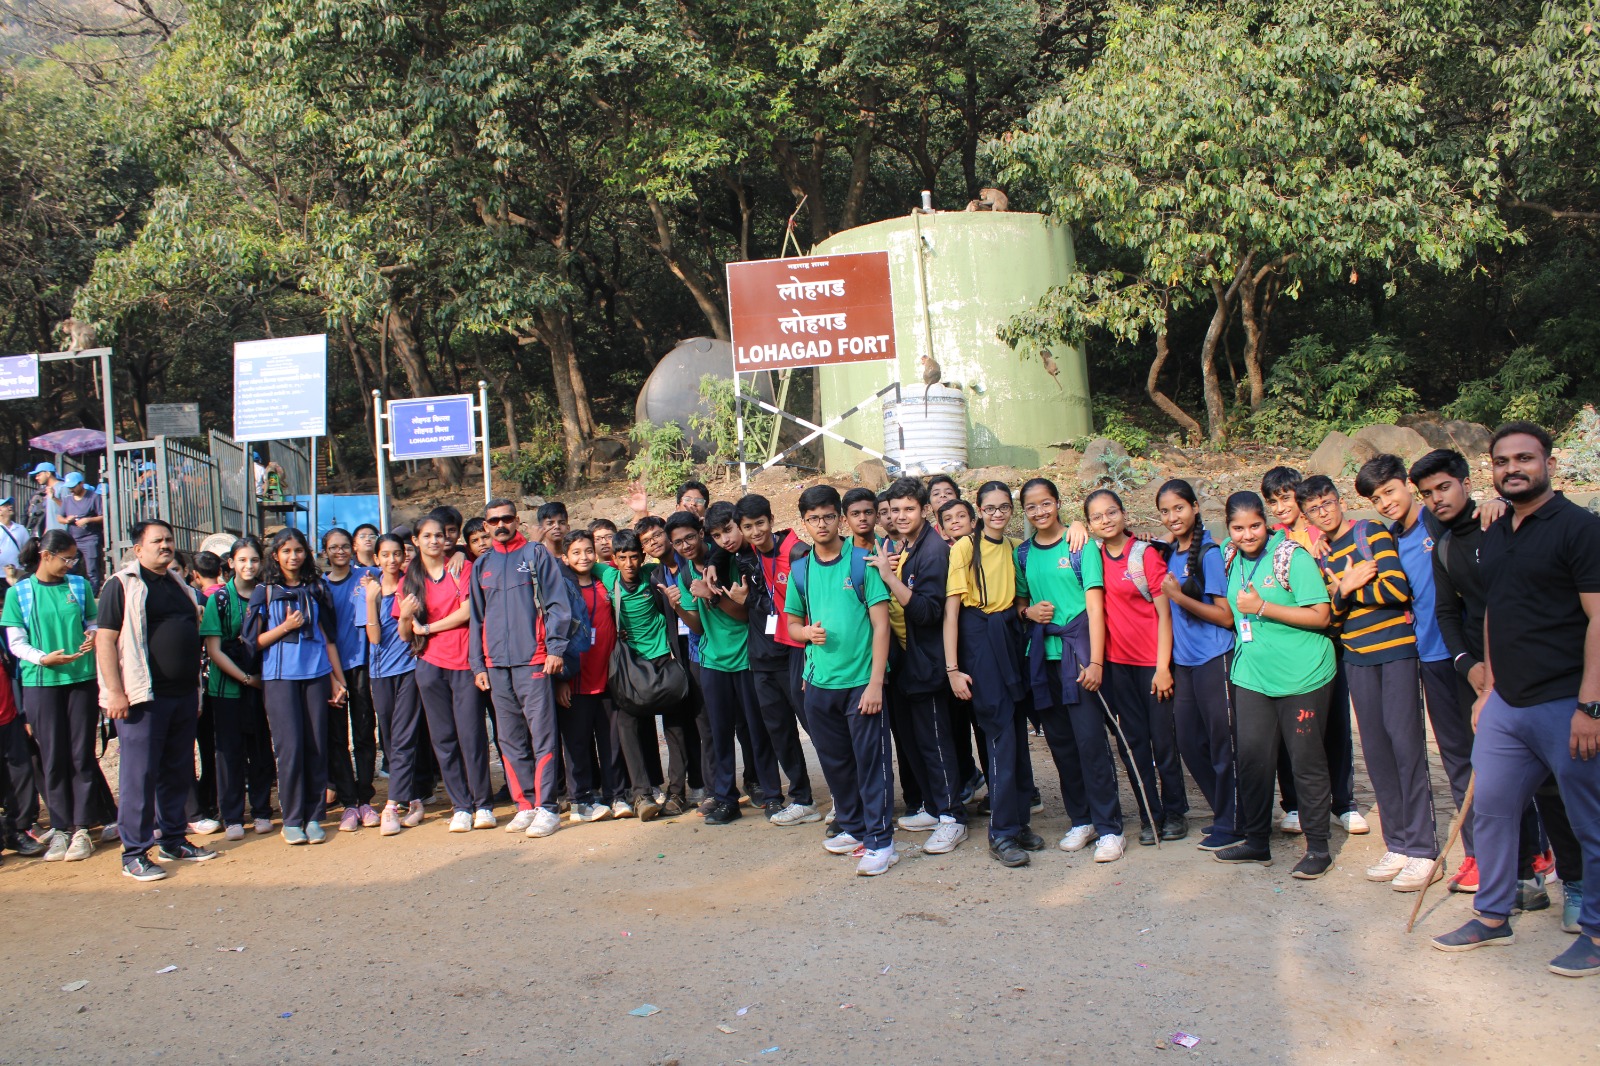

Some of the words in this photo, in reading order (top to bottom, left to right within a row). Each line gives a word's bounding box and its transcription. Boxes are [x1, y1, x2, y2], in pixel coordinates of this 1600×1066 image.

[776, 276, 846, 301] लोहगड
[777, 308, 848, 335] लोहगड
[738, 340, 833, 364] LOHAGAD
[838, 334, 890, 356] FORT
